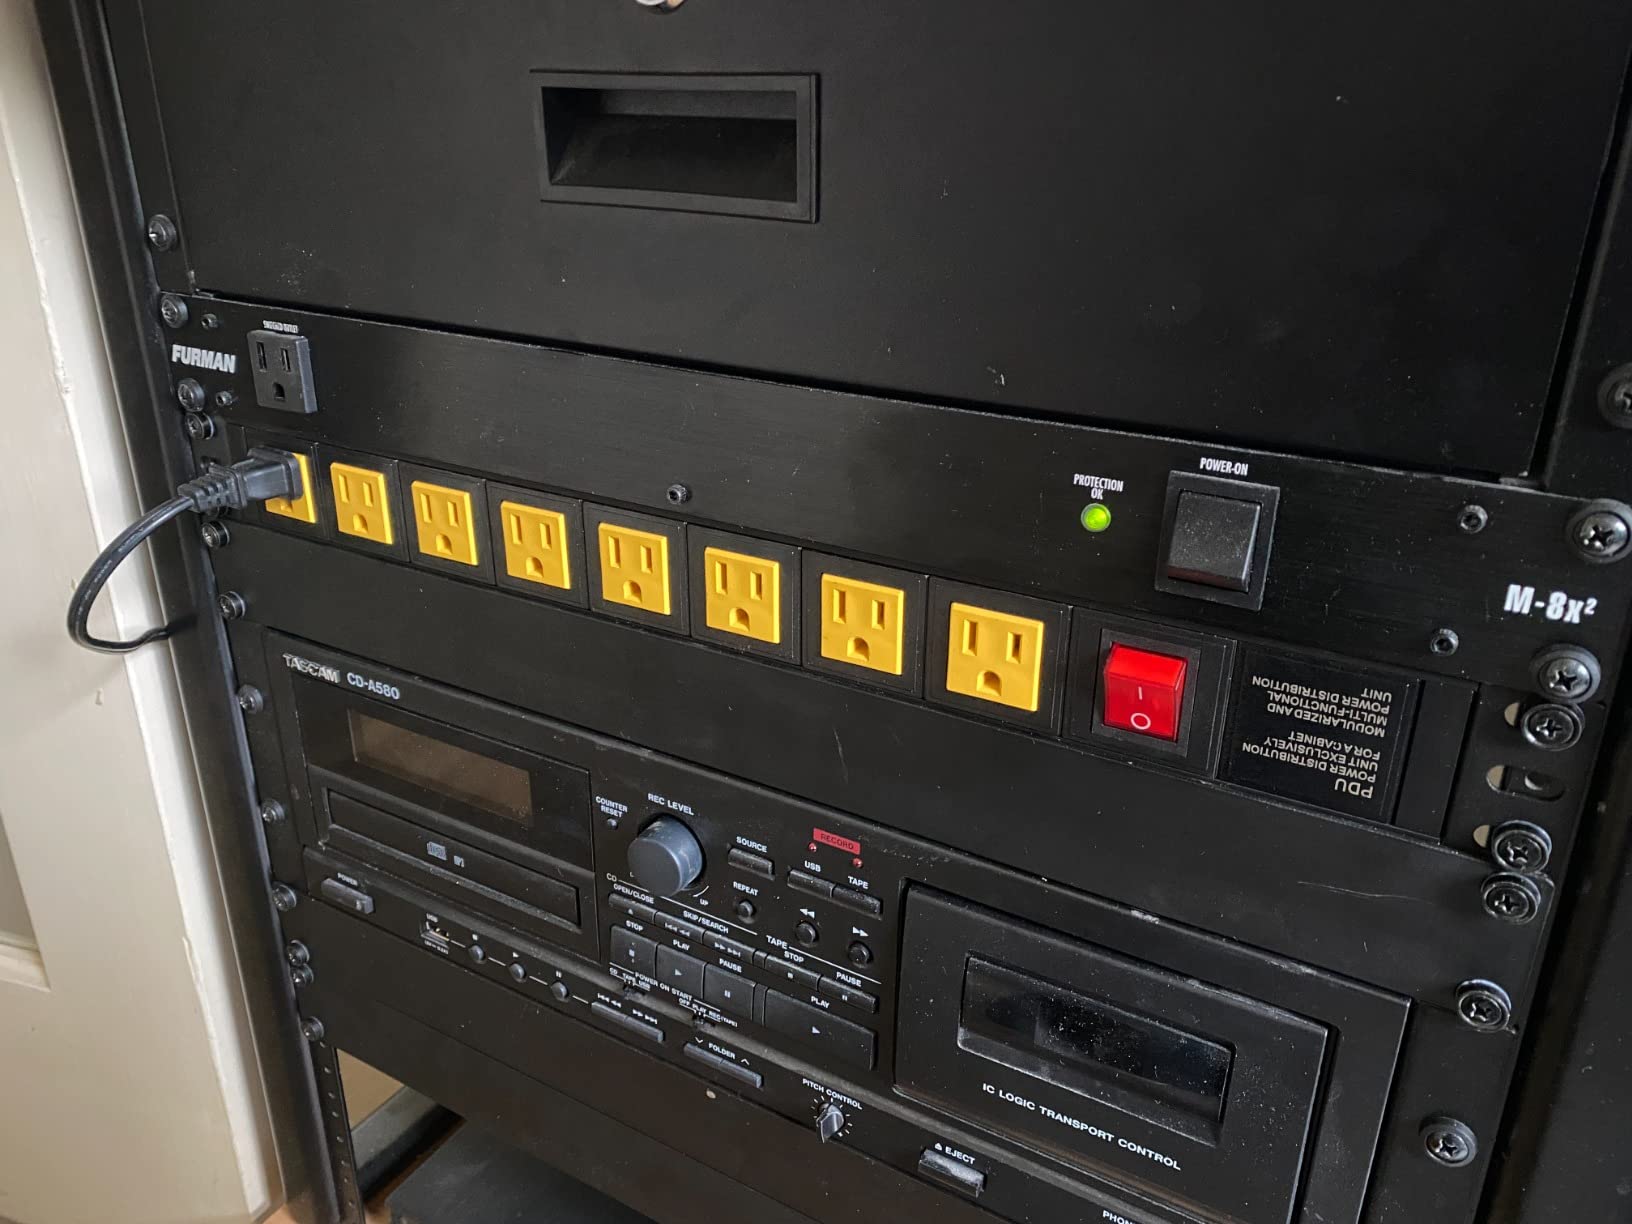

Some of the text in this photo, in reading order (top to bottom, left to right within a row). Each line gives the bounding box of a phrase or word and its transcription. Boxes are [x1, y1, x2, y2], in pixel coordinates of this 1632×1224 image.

[171, 344, 236, 374] FURMAN
[1200, 457, 1248, 476] POWER-ON
[1073, 473, 1124, 492] PROTECTION
[1090, 487, 1103, 500] OK
[282, 652, 400, 700] TASCAM CD-A580
[1252, 675, 1391, 715] POWER DISTRIBUTION
[1360, 687, 1393, 703] UNIT
[1266, 690, 1388, 727] MULTI-FUNCTIONAL
[1266, 702, 1386, 738] MODULARIZED AND
[1263, 736, 1379, 772] UNIT EXCLUSIVELY
[1287, 730, 1381, 761] FOR A CABINET
[1242, 742, 1377, 783] POWER DISTRIBUTION
[1334, 778, 1374, 799] PDU
[595, 795, 628, 813] COUNTER
[600, 804, 623, 818] RESET
[647, 793, 695, 816] REC LEVEL
[736, 835, 768, 854] SOURCE
[820, 833, 854, 850] RECORD
[804, 860, 821, 873] USB
[606, 872, 617, 882] CD
[847, 875, 869, 890] TAPE
[613, 883, 655, 905] OPEN/CLOSE
[732, 881, 759, 896] REPEAT
[699, 898, 709, 906] UP
[625, 920, 644, 932] STOP
[672, 939, 691, 951] PLAY
[766, 934, 788, 950] TAPE
[719, 958, 742, 973] PAUSE
[784, 950, 804, 963] STOP
[635, 971, 693, 1001] POWER ON START
[836, 971, 862, 987] PAUSE
[810, 995, 830, 1009] PLAY
[708, 1042, 736, 1060] FOLDER
[802, 1078, 863, 1111] PITCH CONTROL
[982, 1083, 1181, 1171] IC LOGIC TRANSPORT CONTROL
[945, 1146, 976, 1165] EJECT
